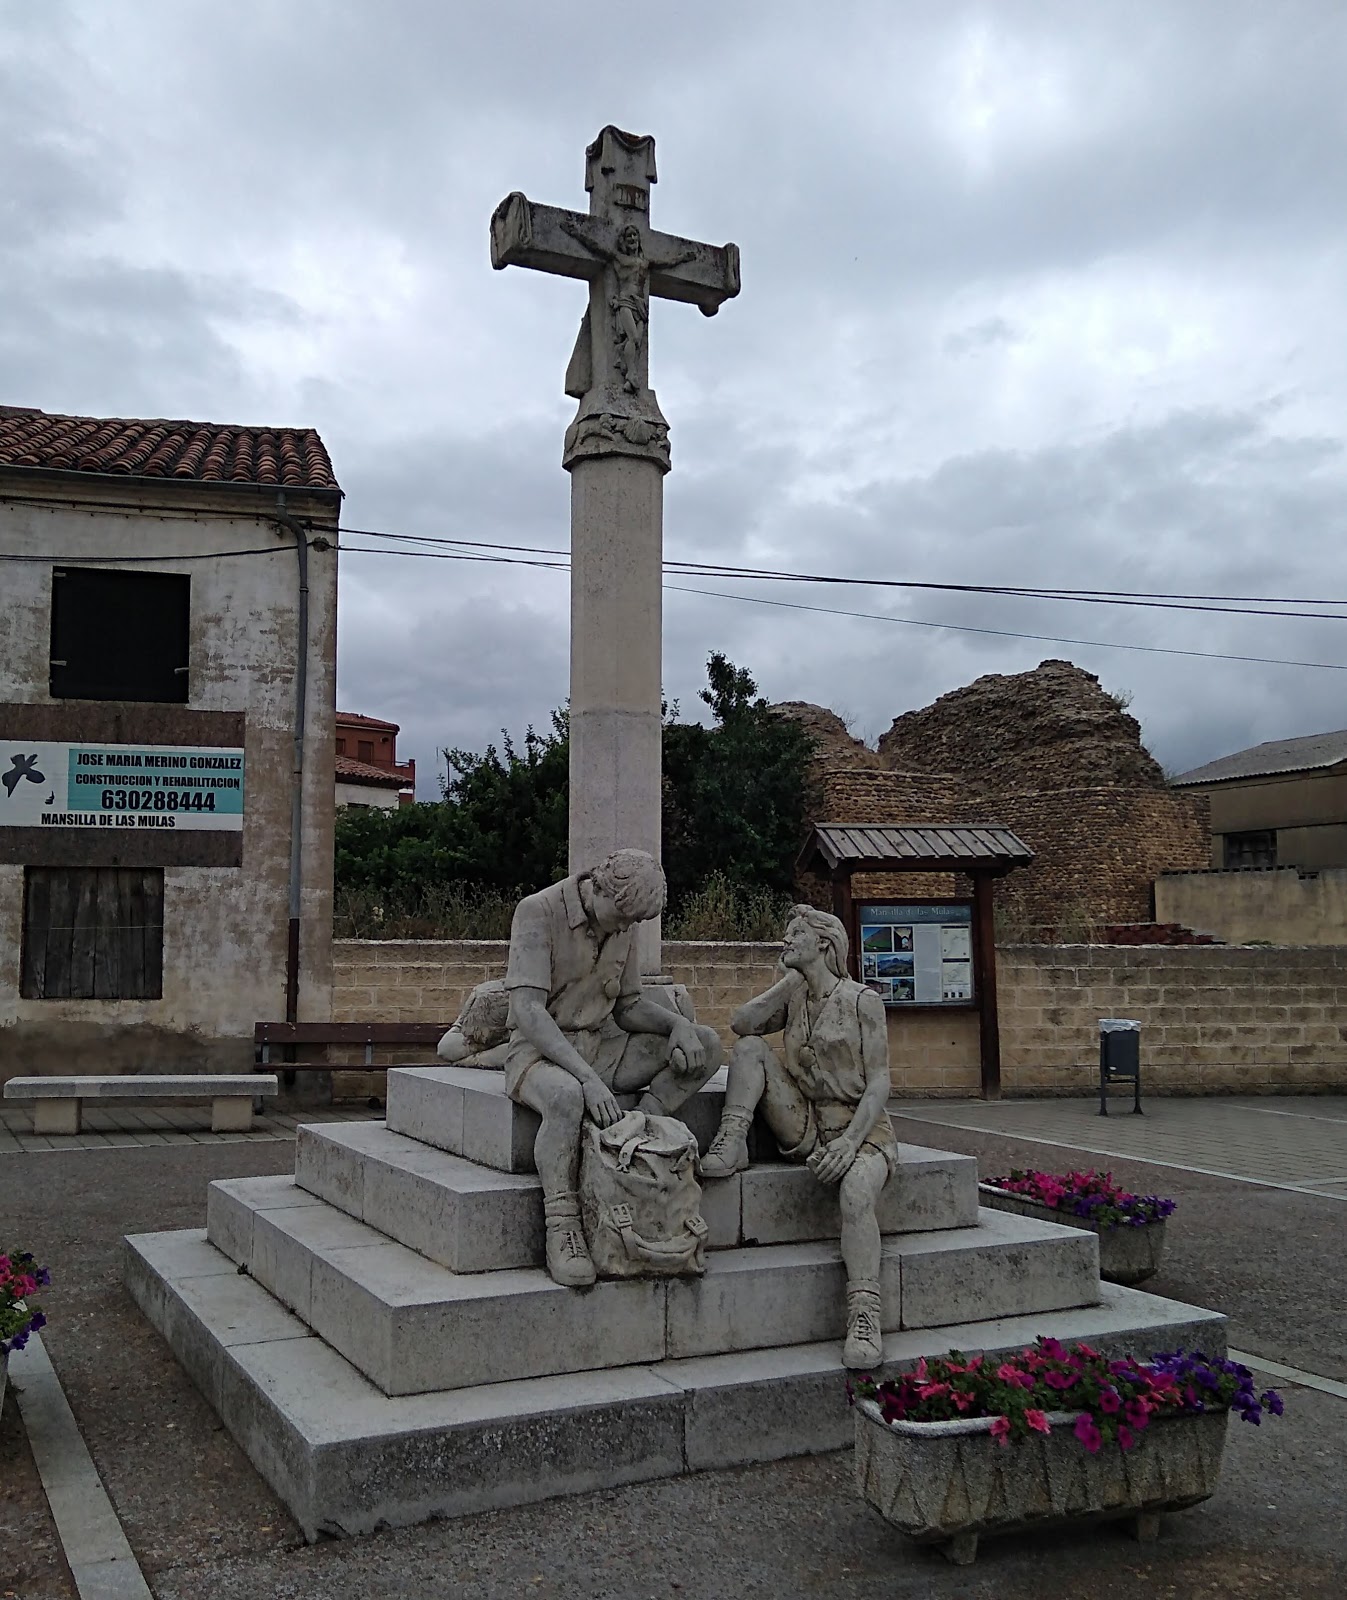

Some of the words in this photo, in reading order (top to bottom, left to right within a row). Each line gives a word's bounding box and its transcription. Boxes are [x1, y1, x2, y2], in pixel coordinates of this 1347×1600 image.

[77, 753, 104, 767] JOSE
[106, 754, 142, 768] MARIA
[144, 755, 187, 769] MERINO
[189, 756, 242, 770] GONZALEZ
[75, 774, 153, 786] CONSTRUCCION
[154, 775, 161, 786] Y
[162, 776, 240, 789] REHABILITACION
[101, 790, 216, 812] 630288444
[41, 813, 97, 826] MANSILLA
[99, 814, 113, 827] DE
[115, 815, 135, 827] LAS
[138, 815, 176, 828] MULAS
[870, 908, 903, 916] Manilla
